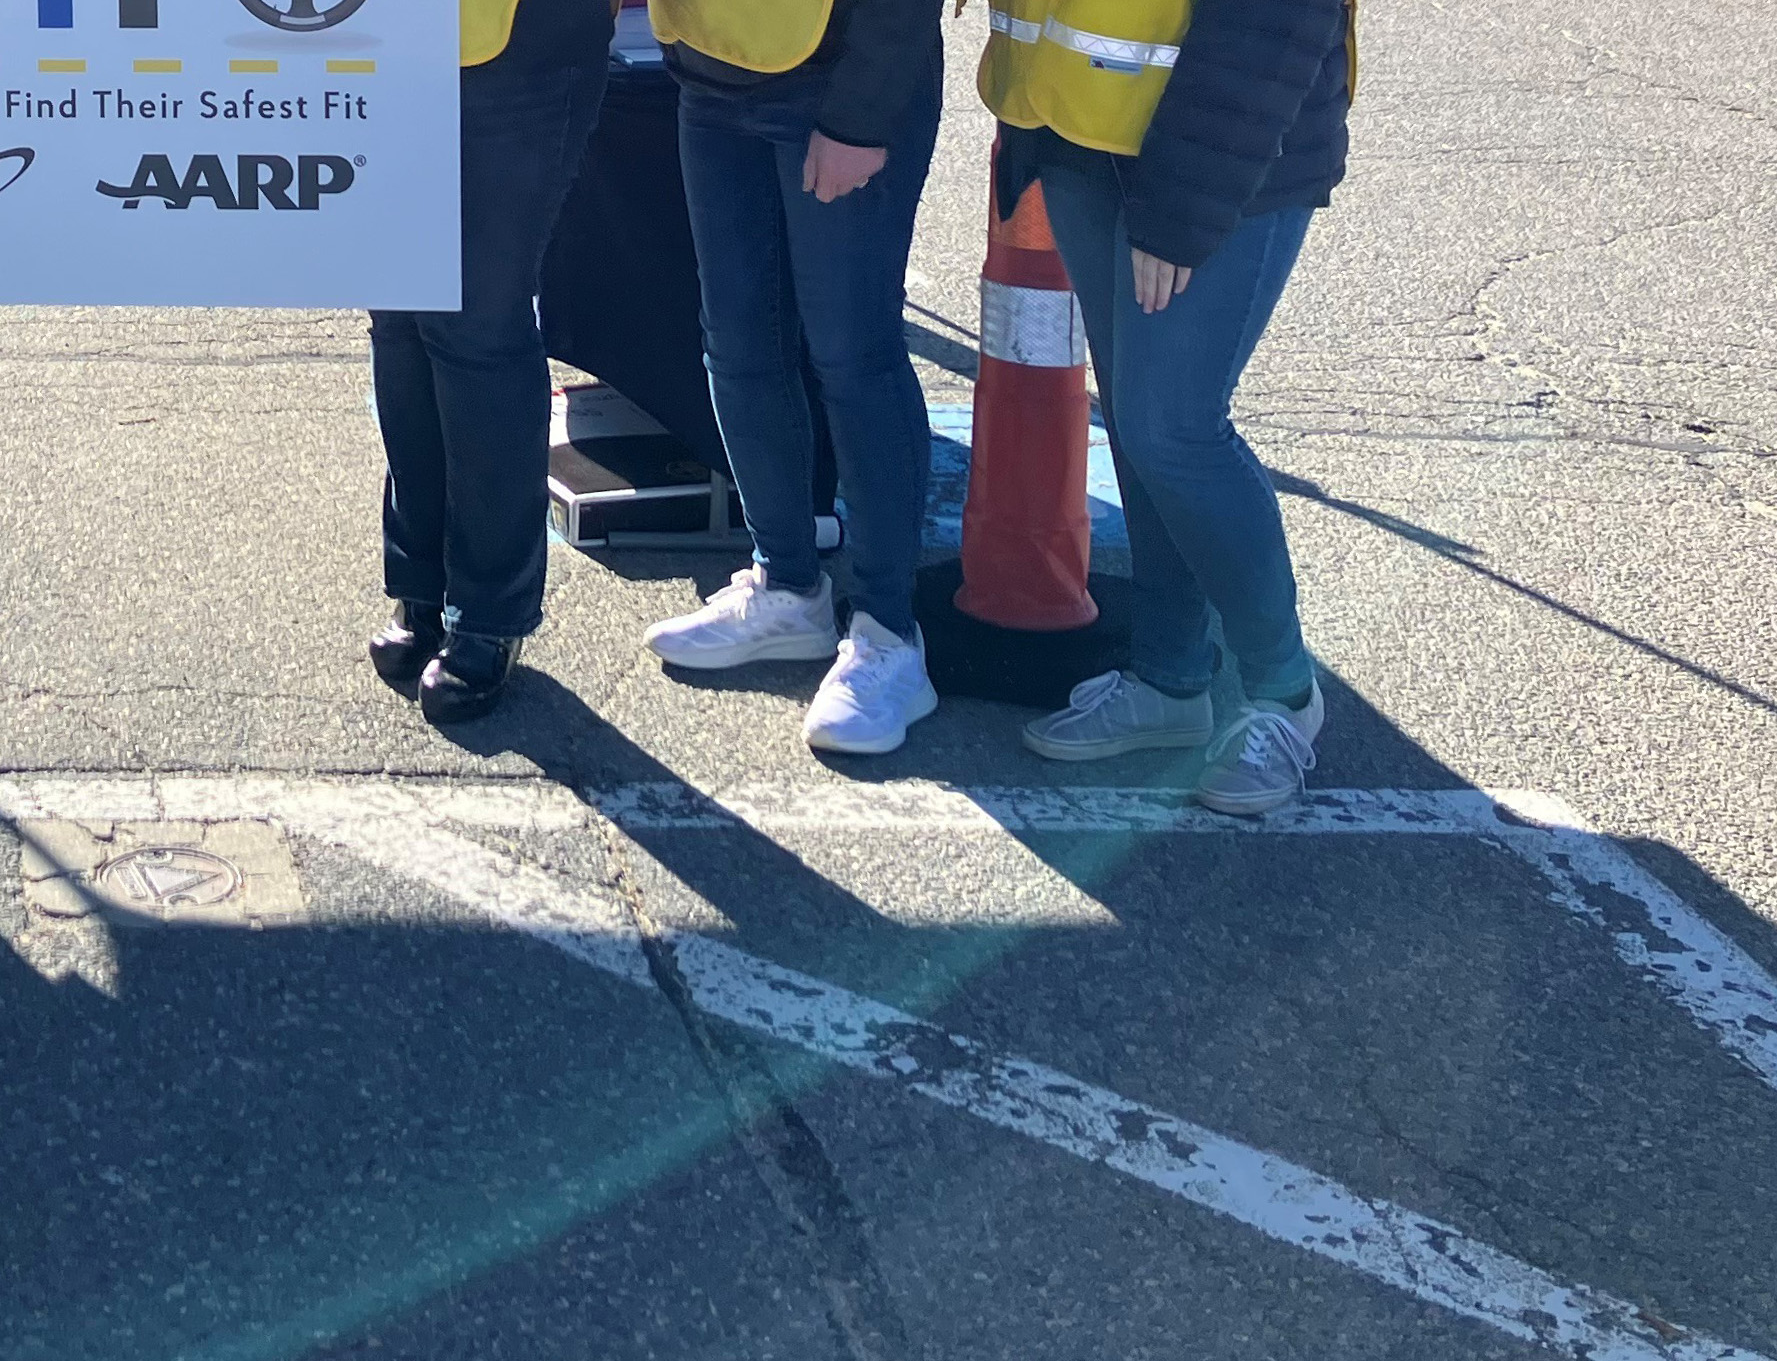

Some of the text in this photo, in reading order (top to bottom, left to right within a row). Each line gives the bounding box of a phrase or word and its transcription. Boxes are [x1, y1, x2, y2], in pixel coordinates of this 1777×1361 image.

[6, 89, 77, 119] Find
[93, 89, 183, 119] Their
[200, 89, 307, 119] Safest
[324, 91, 367, 120] Fit
